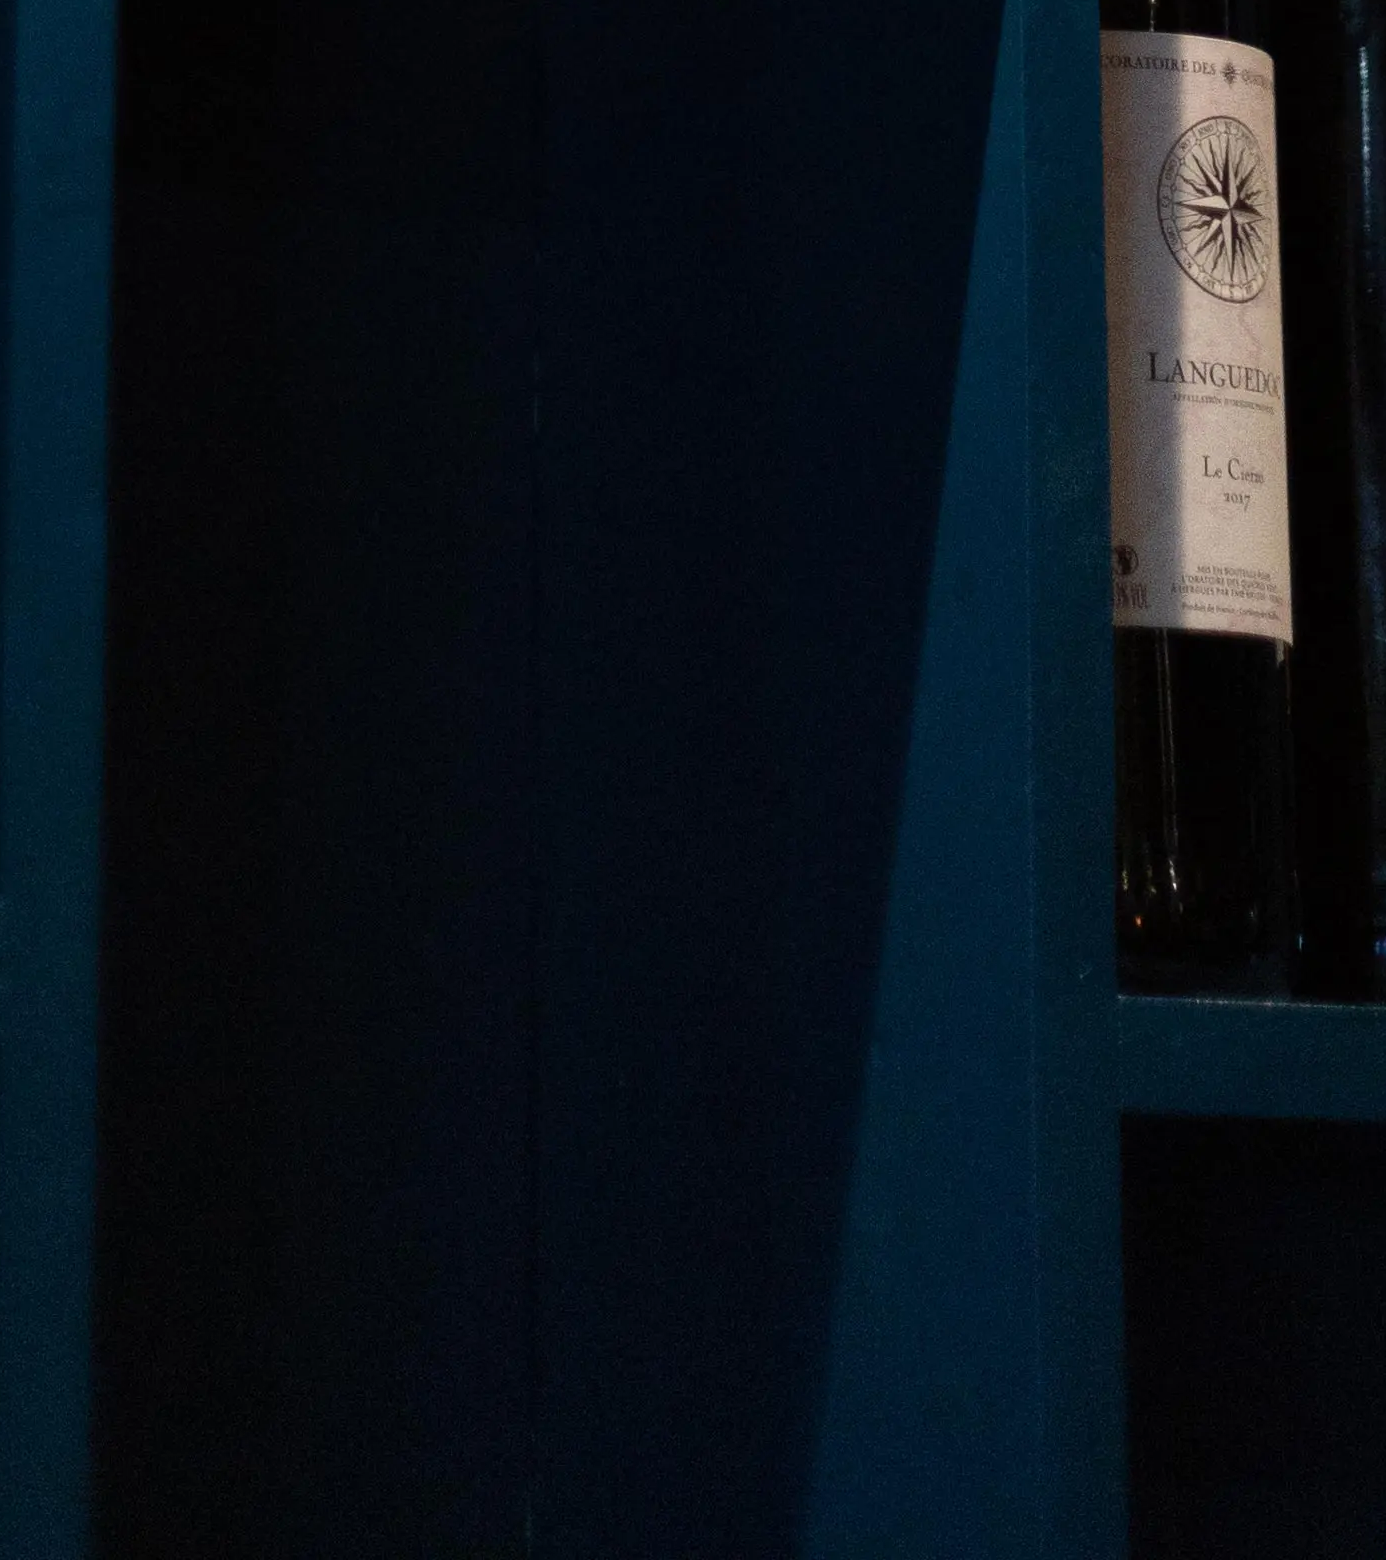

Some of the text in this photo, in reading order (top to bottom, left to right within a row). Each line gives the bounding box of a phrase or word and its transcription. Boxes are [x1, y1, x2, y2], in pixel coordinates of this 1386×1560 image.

[1193, 61, 1216, 76] DES
[1203, 455, 1223, 479] Le
[1223, 492, 1251, 512] 2017
